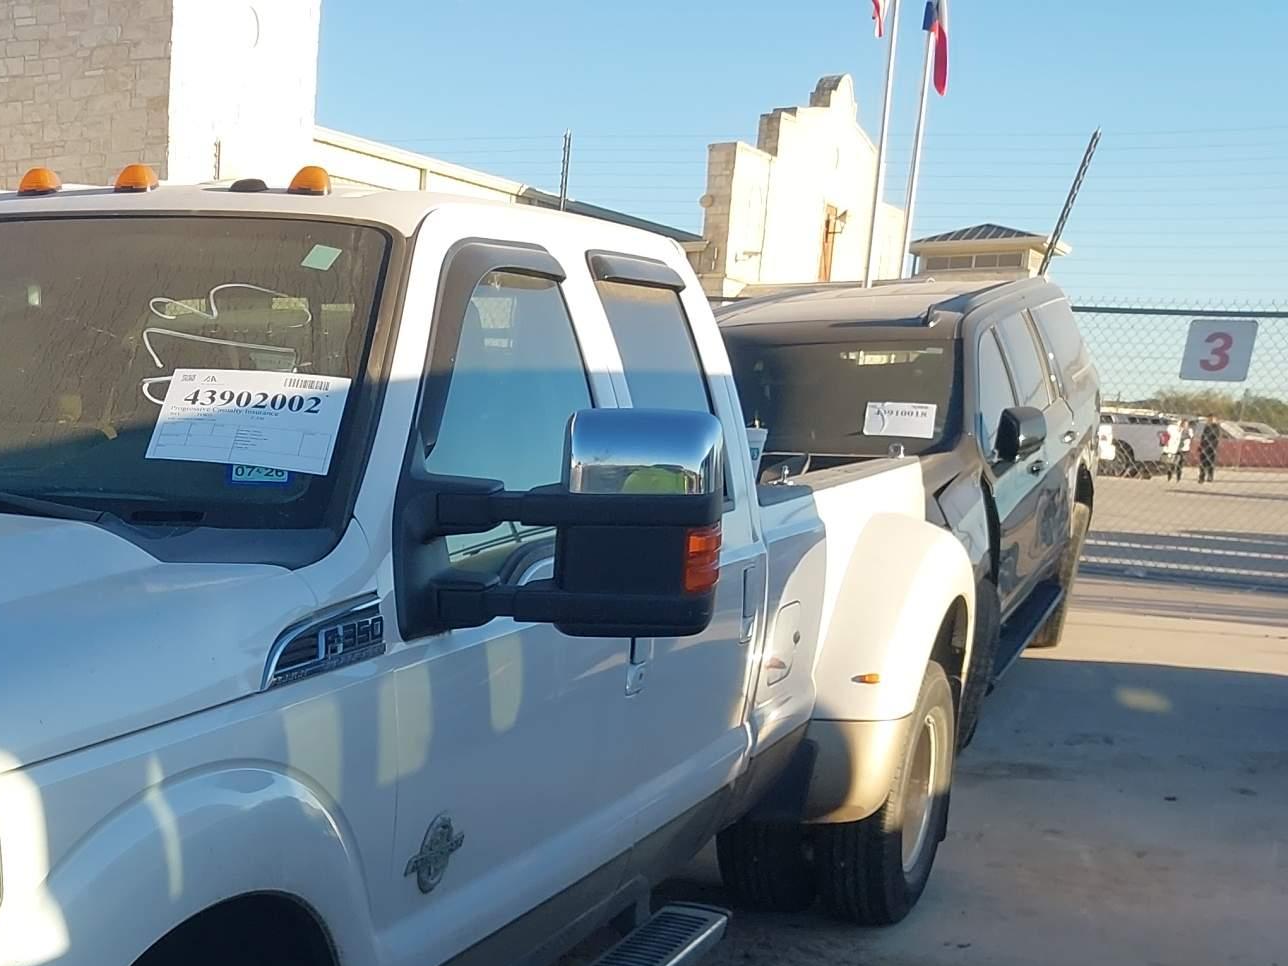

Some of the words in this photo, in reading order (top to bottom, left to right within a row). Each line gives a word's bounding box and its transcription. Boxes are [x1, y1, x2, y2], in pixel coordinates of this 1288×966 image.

[1199, 332, 1233, 372] 3
[184, 388, 322, 414] 43902002
[212, 406, 242, 415] Casualty
[245, 408, 280, 418] Insurance
